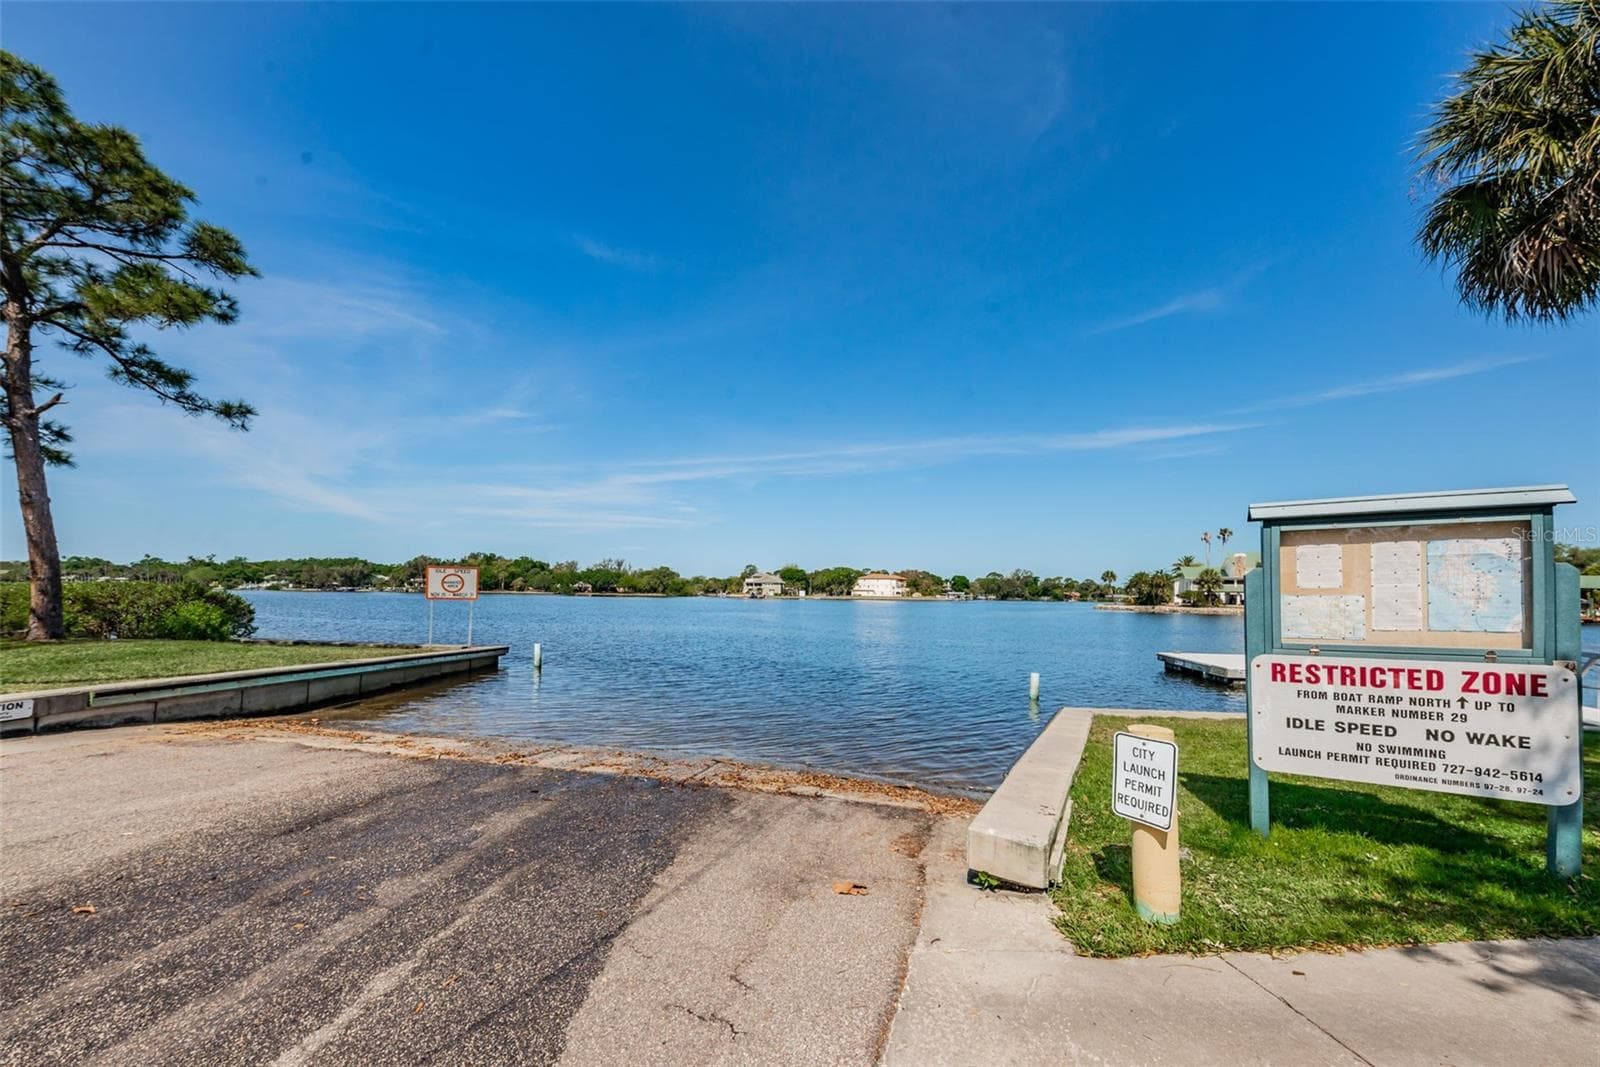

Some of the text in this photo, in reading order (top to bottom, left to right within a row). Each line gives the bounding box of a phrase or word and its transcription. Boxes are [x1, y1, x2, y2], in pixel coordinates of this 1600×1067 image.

[1271, 662, 1549, 697] RESTRICTED ZONE
[0, 701, 24, 711] ION
[1297, 689, 1515, 713] FROM BOAT RAMP NORTH UP TO
[1336, 704, 1468, 723] MARKER NUMBER 29
[1286, 717, 1532, 750] IDLE SPEED NO WAKE
[1132, 747, 1155, 761] CITY
[1356, 742, 1446, 760] NO SWIMMING
[1123, 761, 1165, 781] LAUNCH
[1278, 746, 1543, 784] LAUNCH PERMIT REQUIRED 727-942-5614
[1125, 778, 1162, 797] PERMIT
[1394, 773, 1439, 785] ORDINANCE
[1441, 779, 1481, 789] NUMBERS
[1117, 793, 1168, 817] REQUIRED
